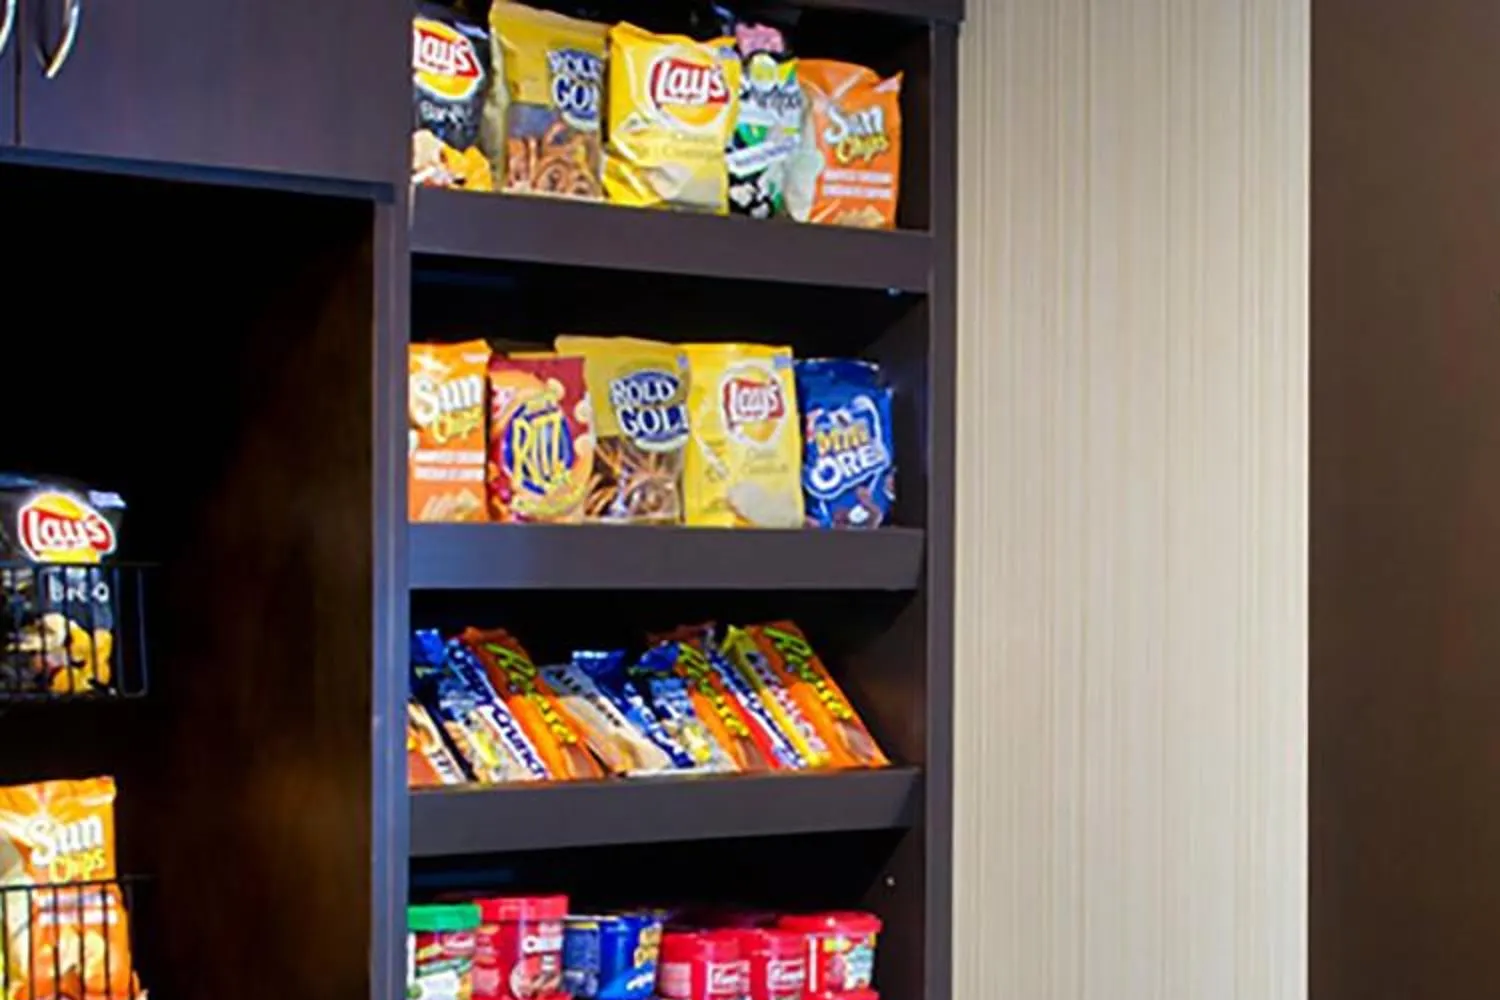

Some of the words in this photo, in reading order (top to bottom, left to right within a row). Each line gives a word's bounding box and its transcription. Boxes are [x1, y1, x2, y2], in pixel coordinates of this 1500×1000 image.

[824, 105, 884, 144] Sun
[410, 374, 484, 426] Sun
[609, 376, 677, 406] ROLD
[28, 813, 105, 868] Sun
